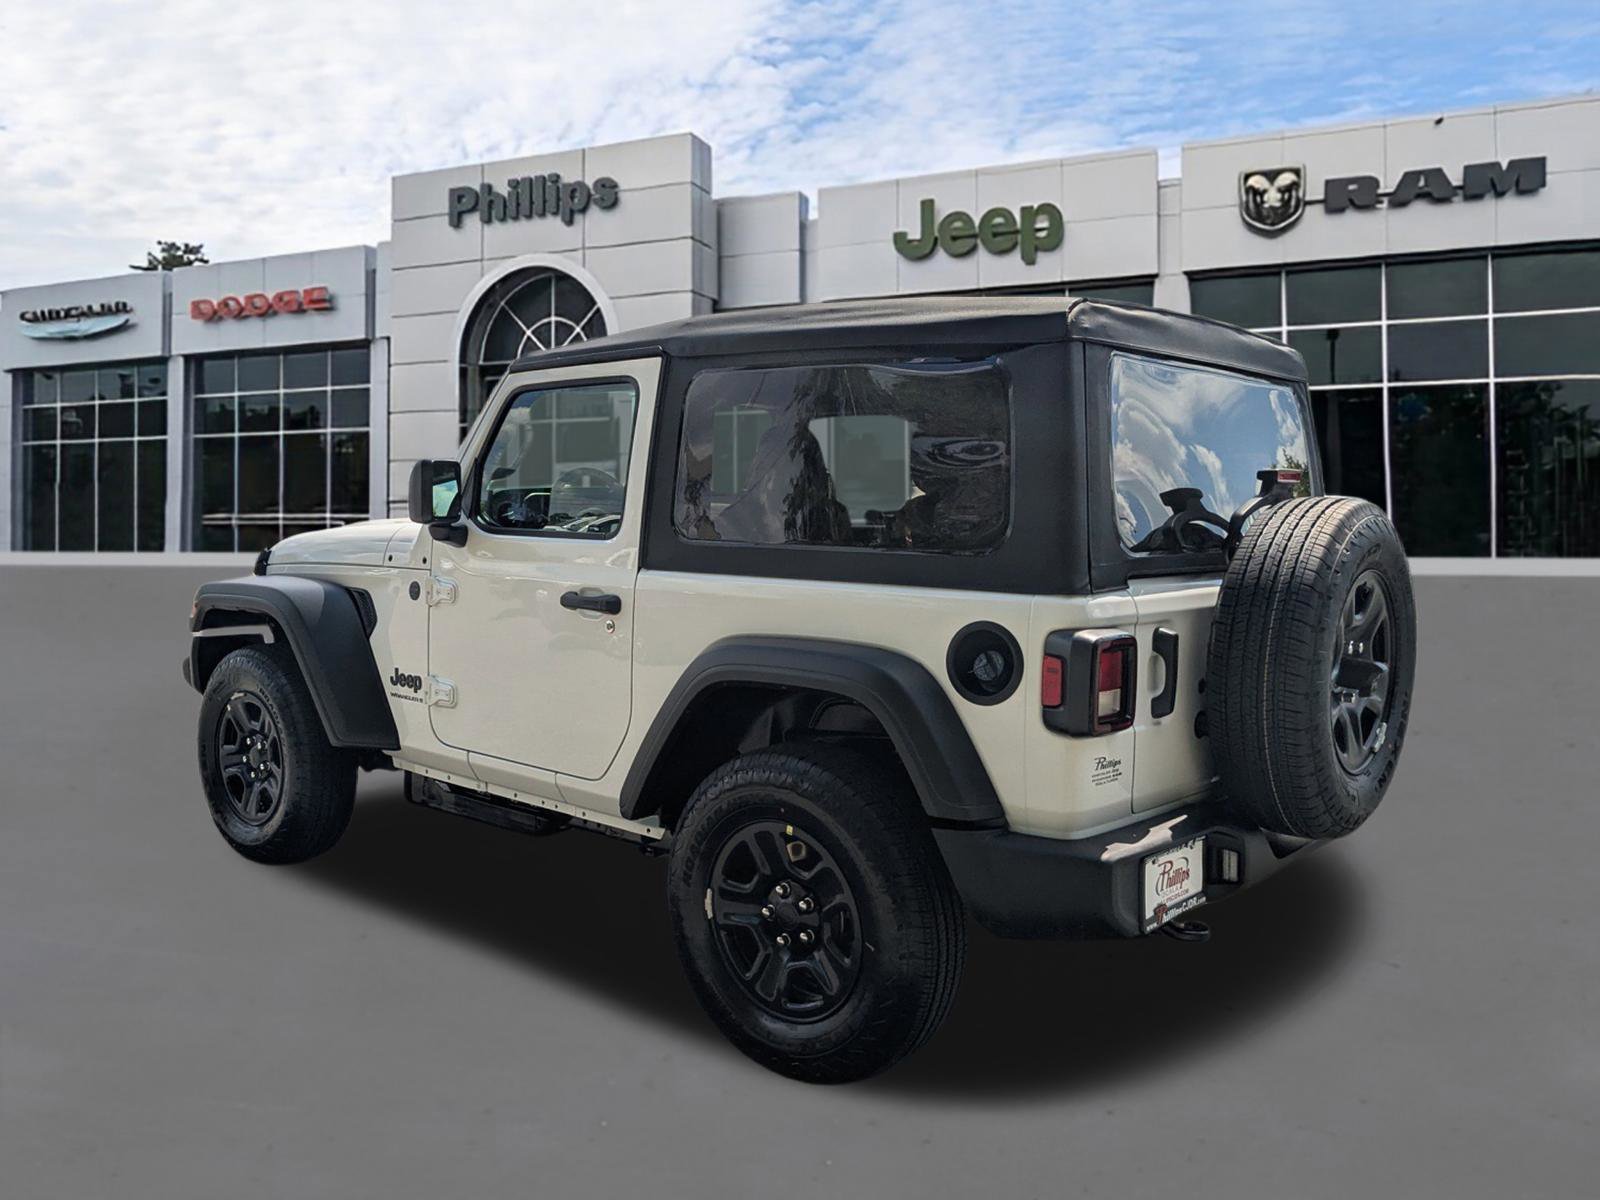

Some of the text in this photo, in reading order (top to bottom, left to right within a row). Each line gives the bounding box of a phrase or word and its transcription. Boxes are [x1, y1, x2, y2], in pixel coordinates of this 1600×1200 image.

[448, 172, 620, 228] Phillips
[1324, 156, 1548, 215] RAM
[893, 198, 1065, 266] Jeep
[190, 286, 332, 320] DODGE
[389, 667, 423, 694] Jeep
